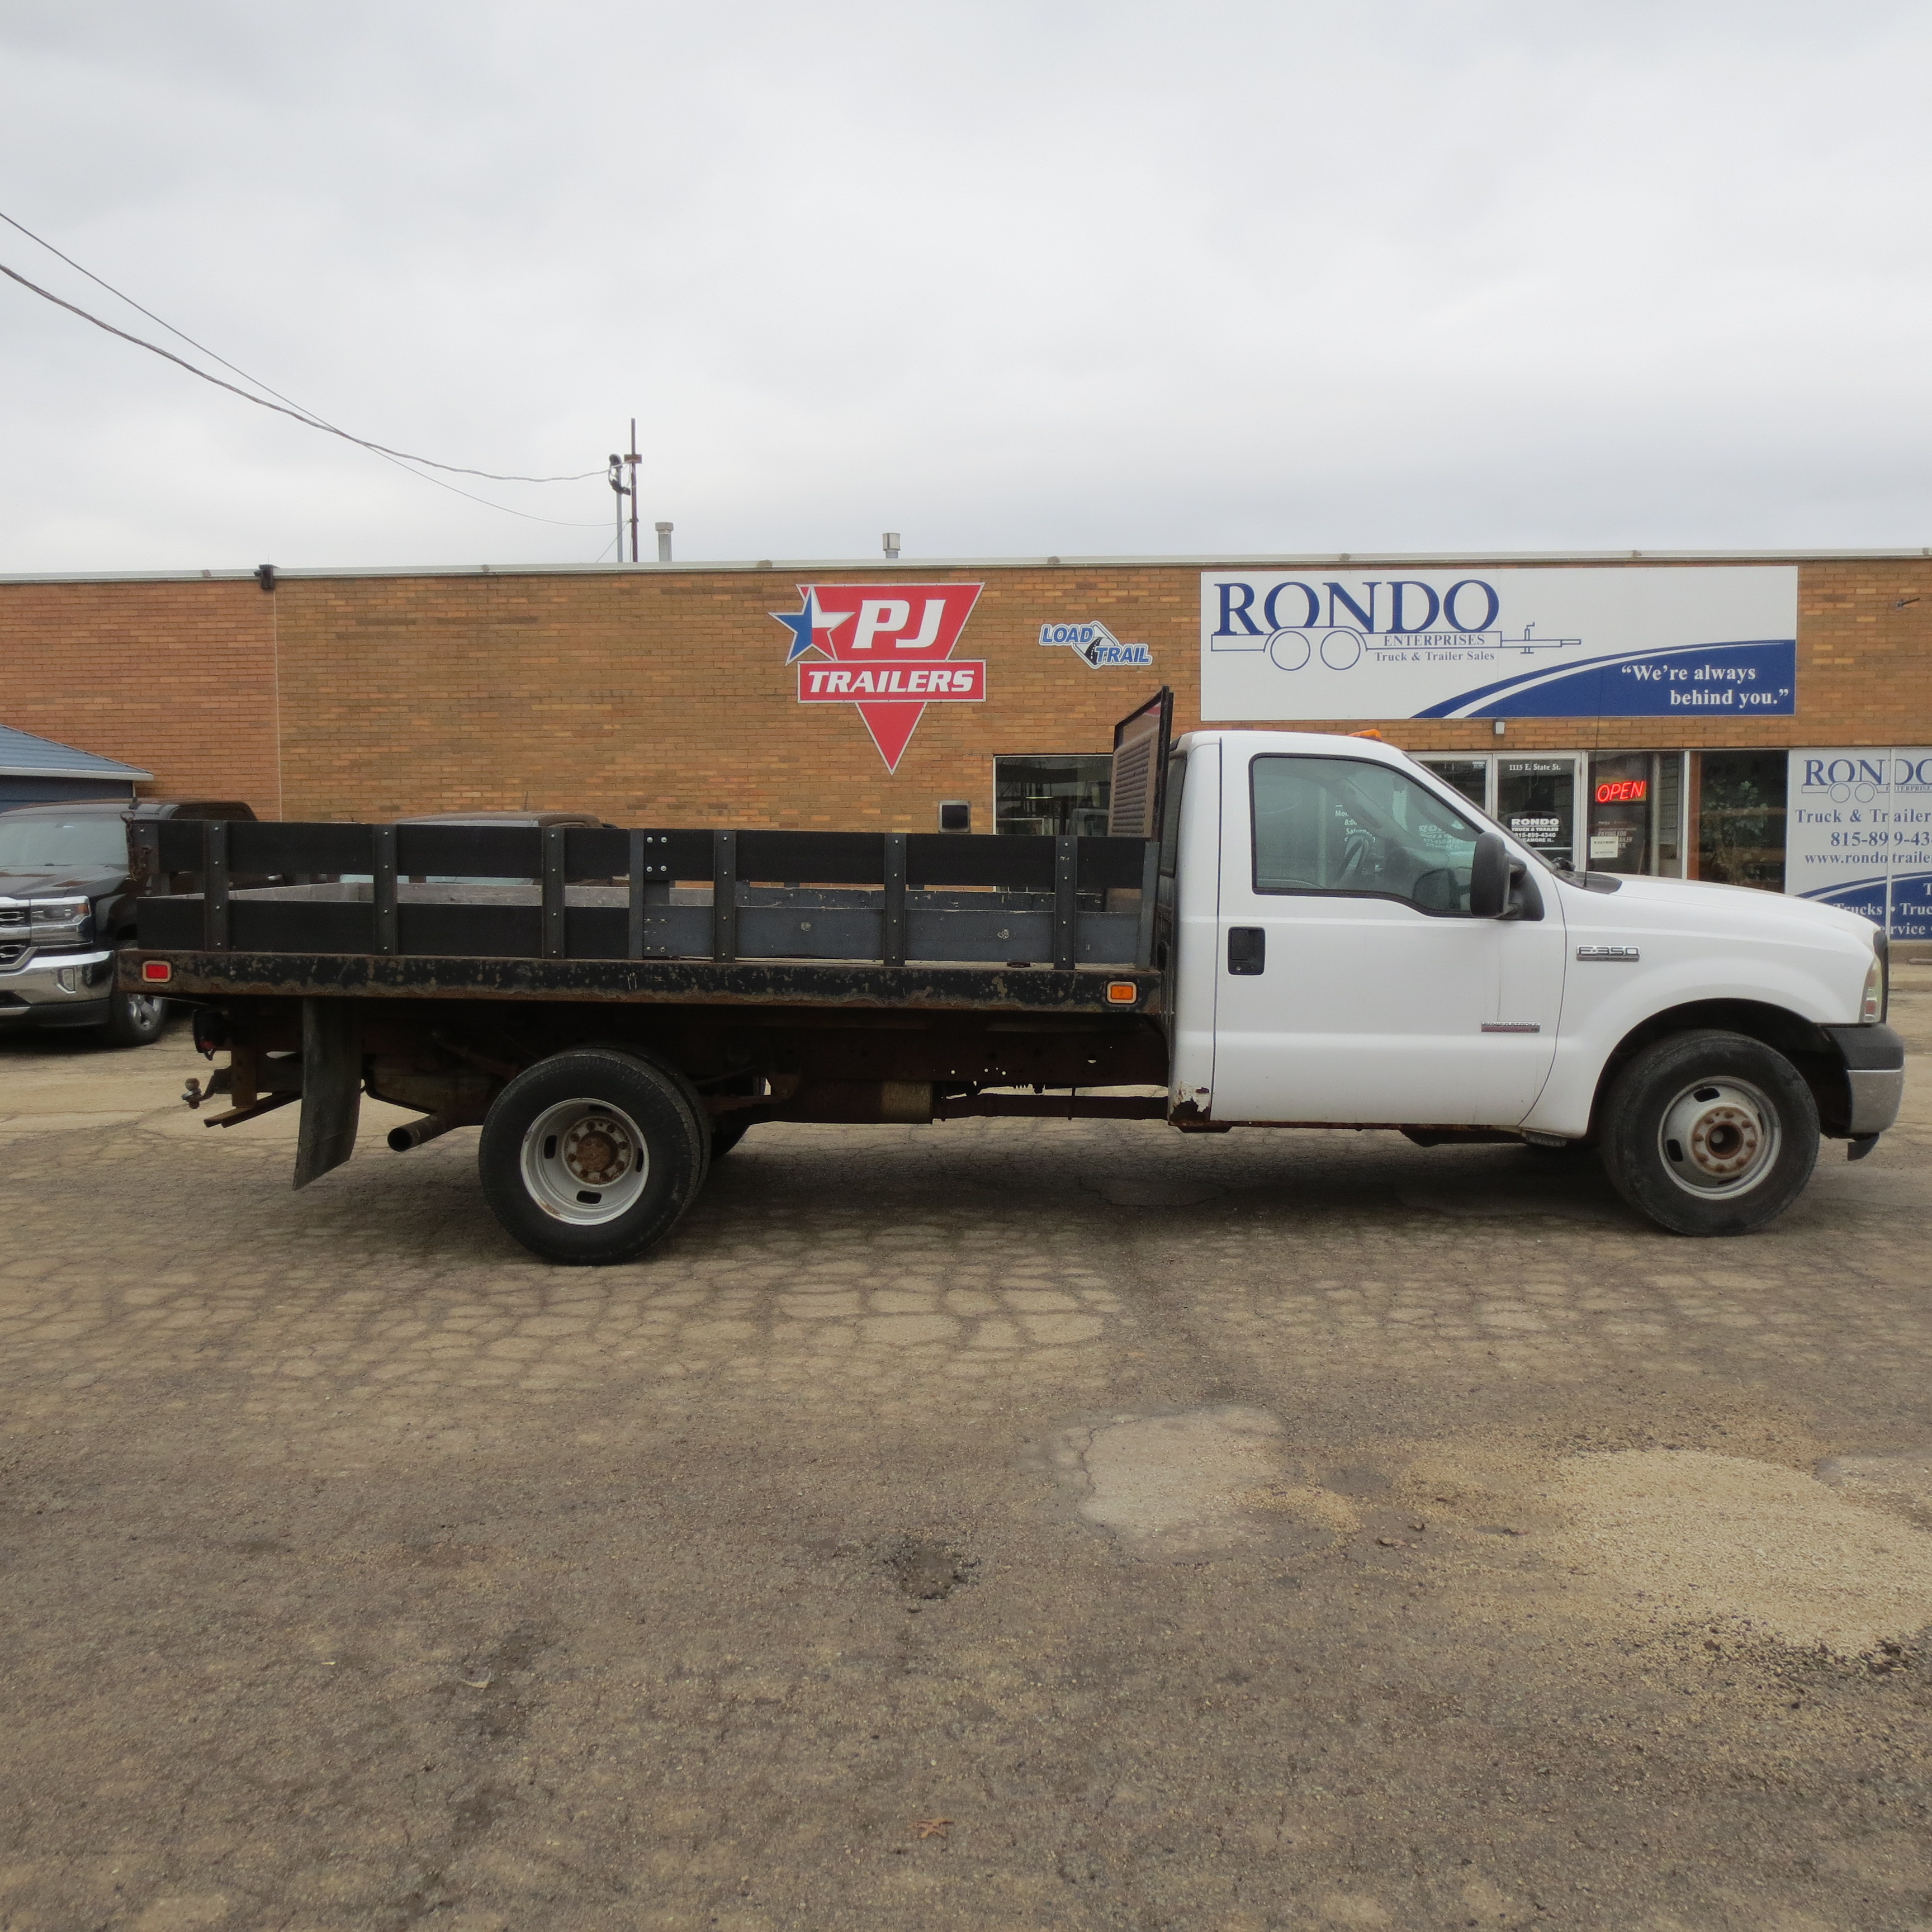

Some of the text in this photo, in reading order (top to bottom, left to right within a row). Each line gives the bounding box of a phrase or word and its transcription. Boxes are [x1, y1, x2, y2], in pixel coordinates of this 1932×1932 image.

[1214, 580, 1499, 635] RONDO
[851, 600, 946, 648] PJ
[1042, 627, 1093, 643] LOAD
[1384, 634, 1485, 647] ENTERPRISES
[1095, 647, 1149, 662] TRAIL
[1374, 651, 1495, 662] Truck & Trailer Sales
[808, 670, 974, 693] TRAILERS
[1694, 665, 1756, 684] always
[1670, 689, 1789, 708] behind you.”
[1804, 759, 1932, 785] RONDO
[1597, 781, 1646, 802] OPEN
[1795, 808, 1931, 823] Truck & Trailer
[1831, 832, 1932, 846] 815-899-43
[1579, 947, 1639, 956] F-350
